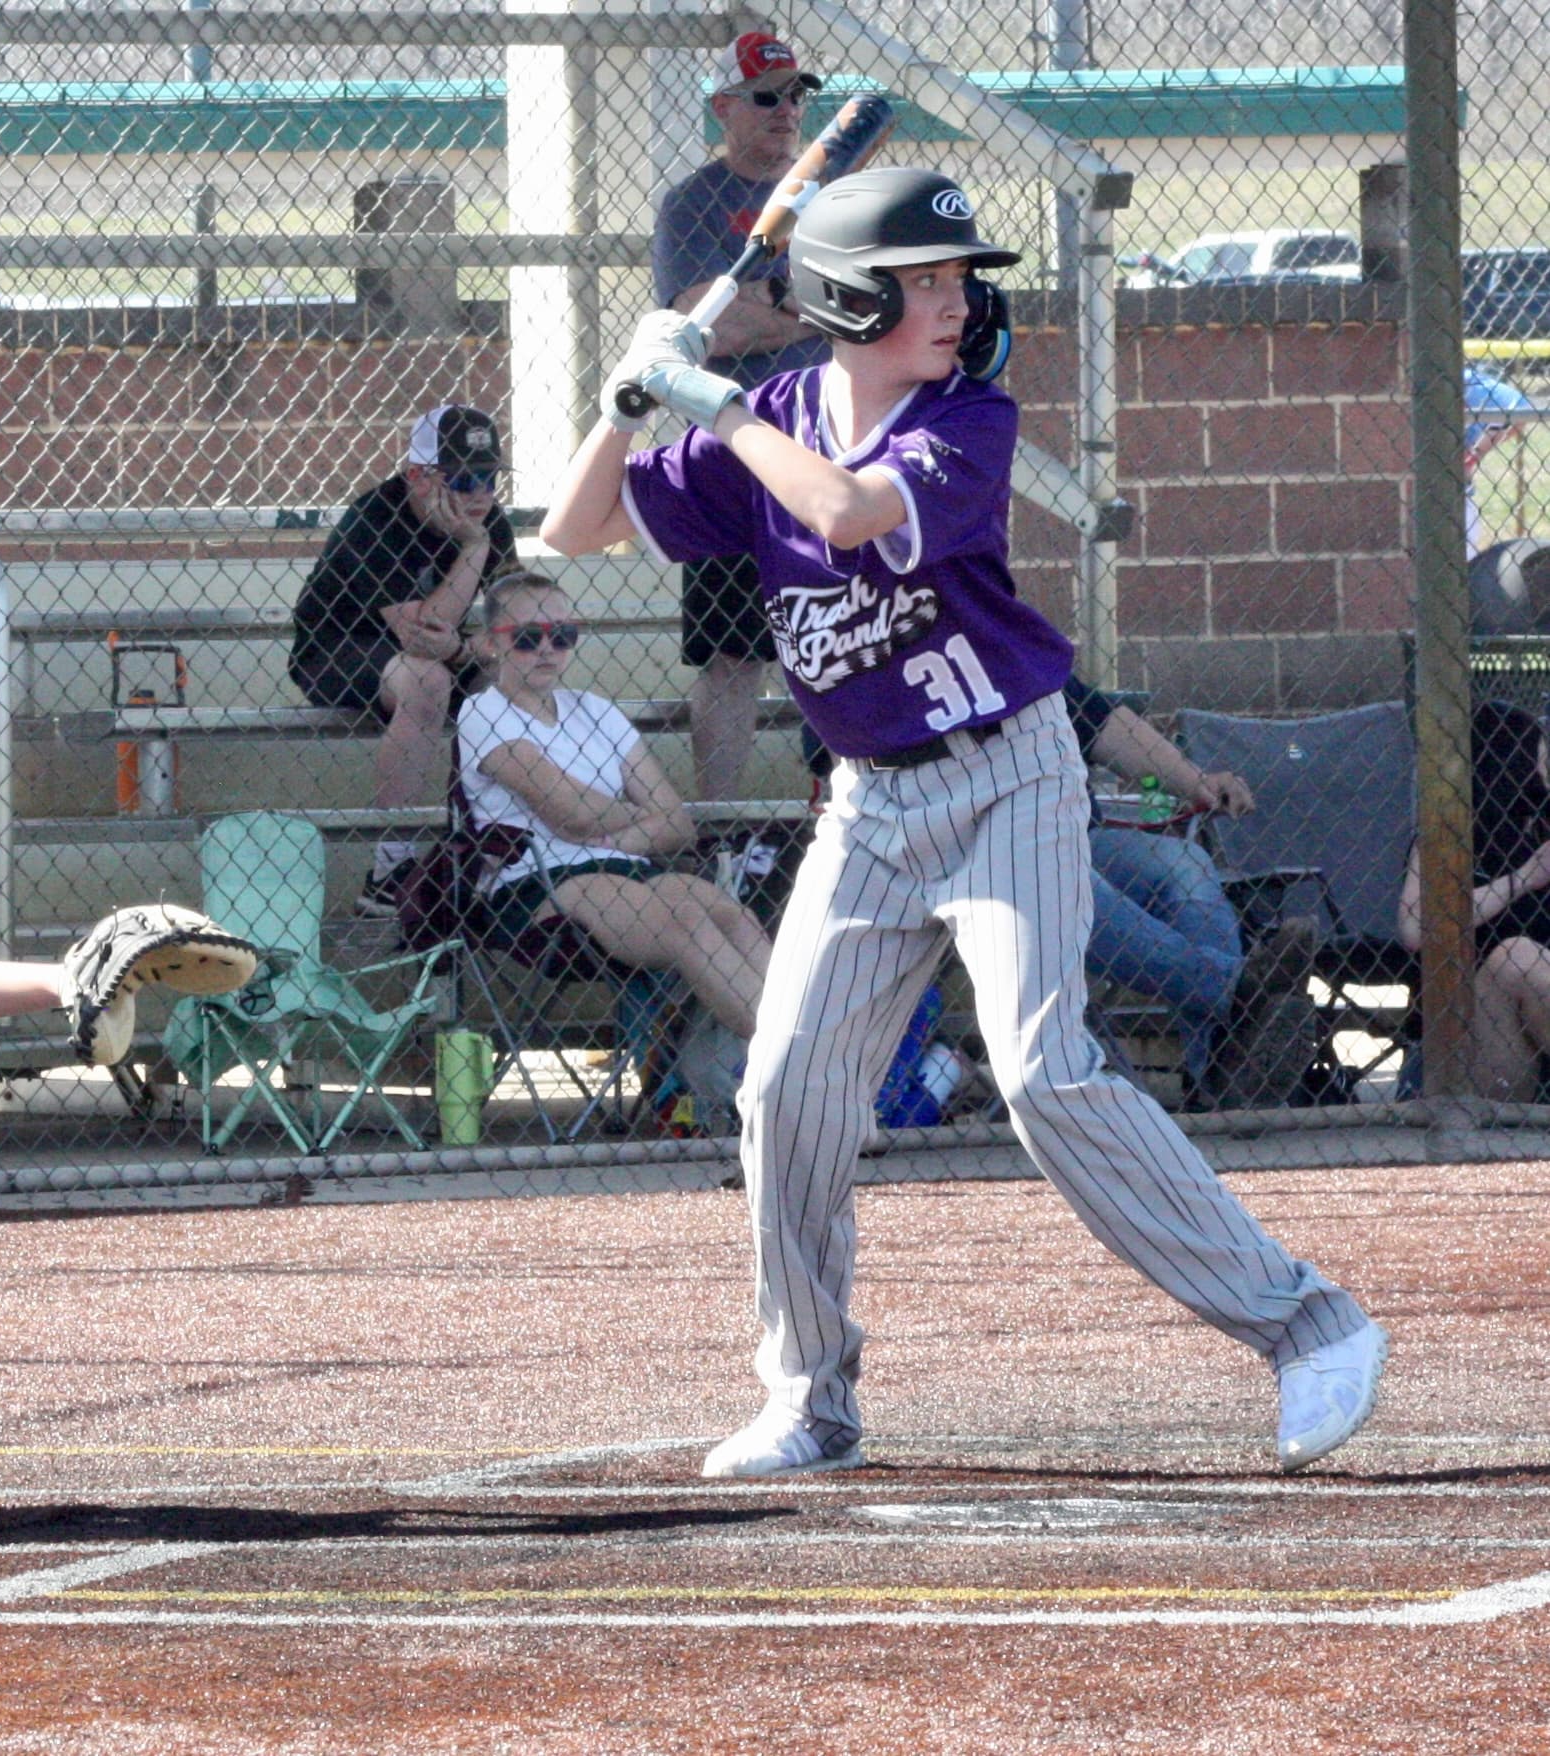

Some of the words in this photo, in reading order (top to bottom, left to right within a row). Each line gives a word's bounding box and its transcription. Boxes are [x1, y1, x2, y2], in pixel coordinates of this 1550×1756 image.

[780, 574, 878, 634] Trash
[800, 584, 928, 678] Pands
[903, 633, 1006, 731] 31
